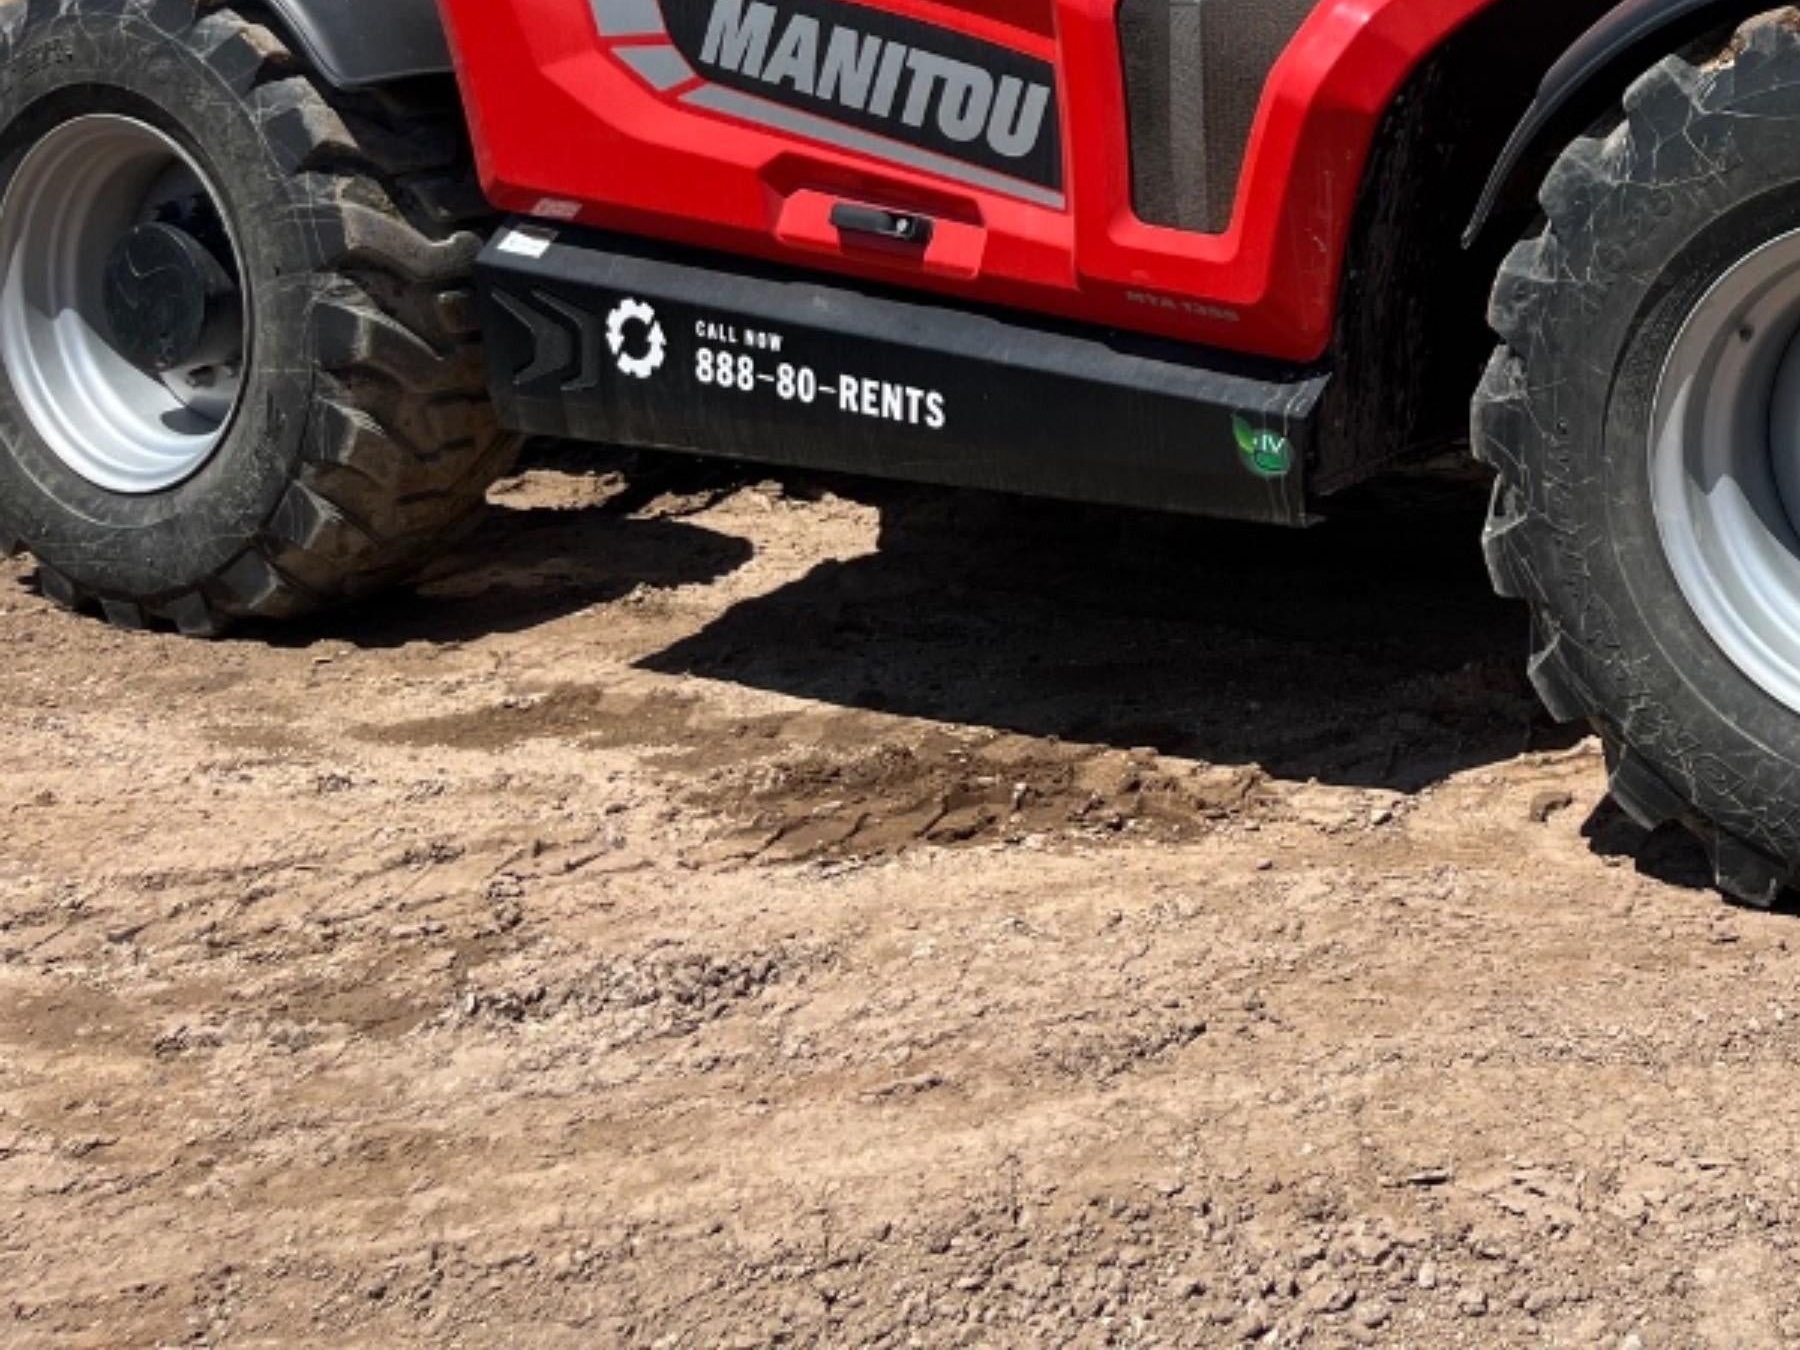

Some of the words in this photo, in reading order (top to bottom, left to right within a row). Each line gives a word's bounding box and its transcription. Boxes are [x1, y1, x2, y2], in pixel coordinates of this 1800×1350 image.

[695, 320, 738, 343] CALL
[744, 329, 783, 352] NOW
[695, 347, 946, 429] 888-80-RENTS
